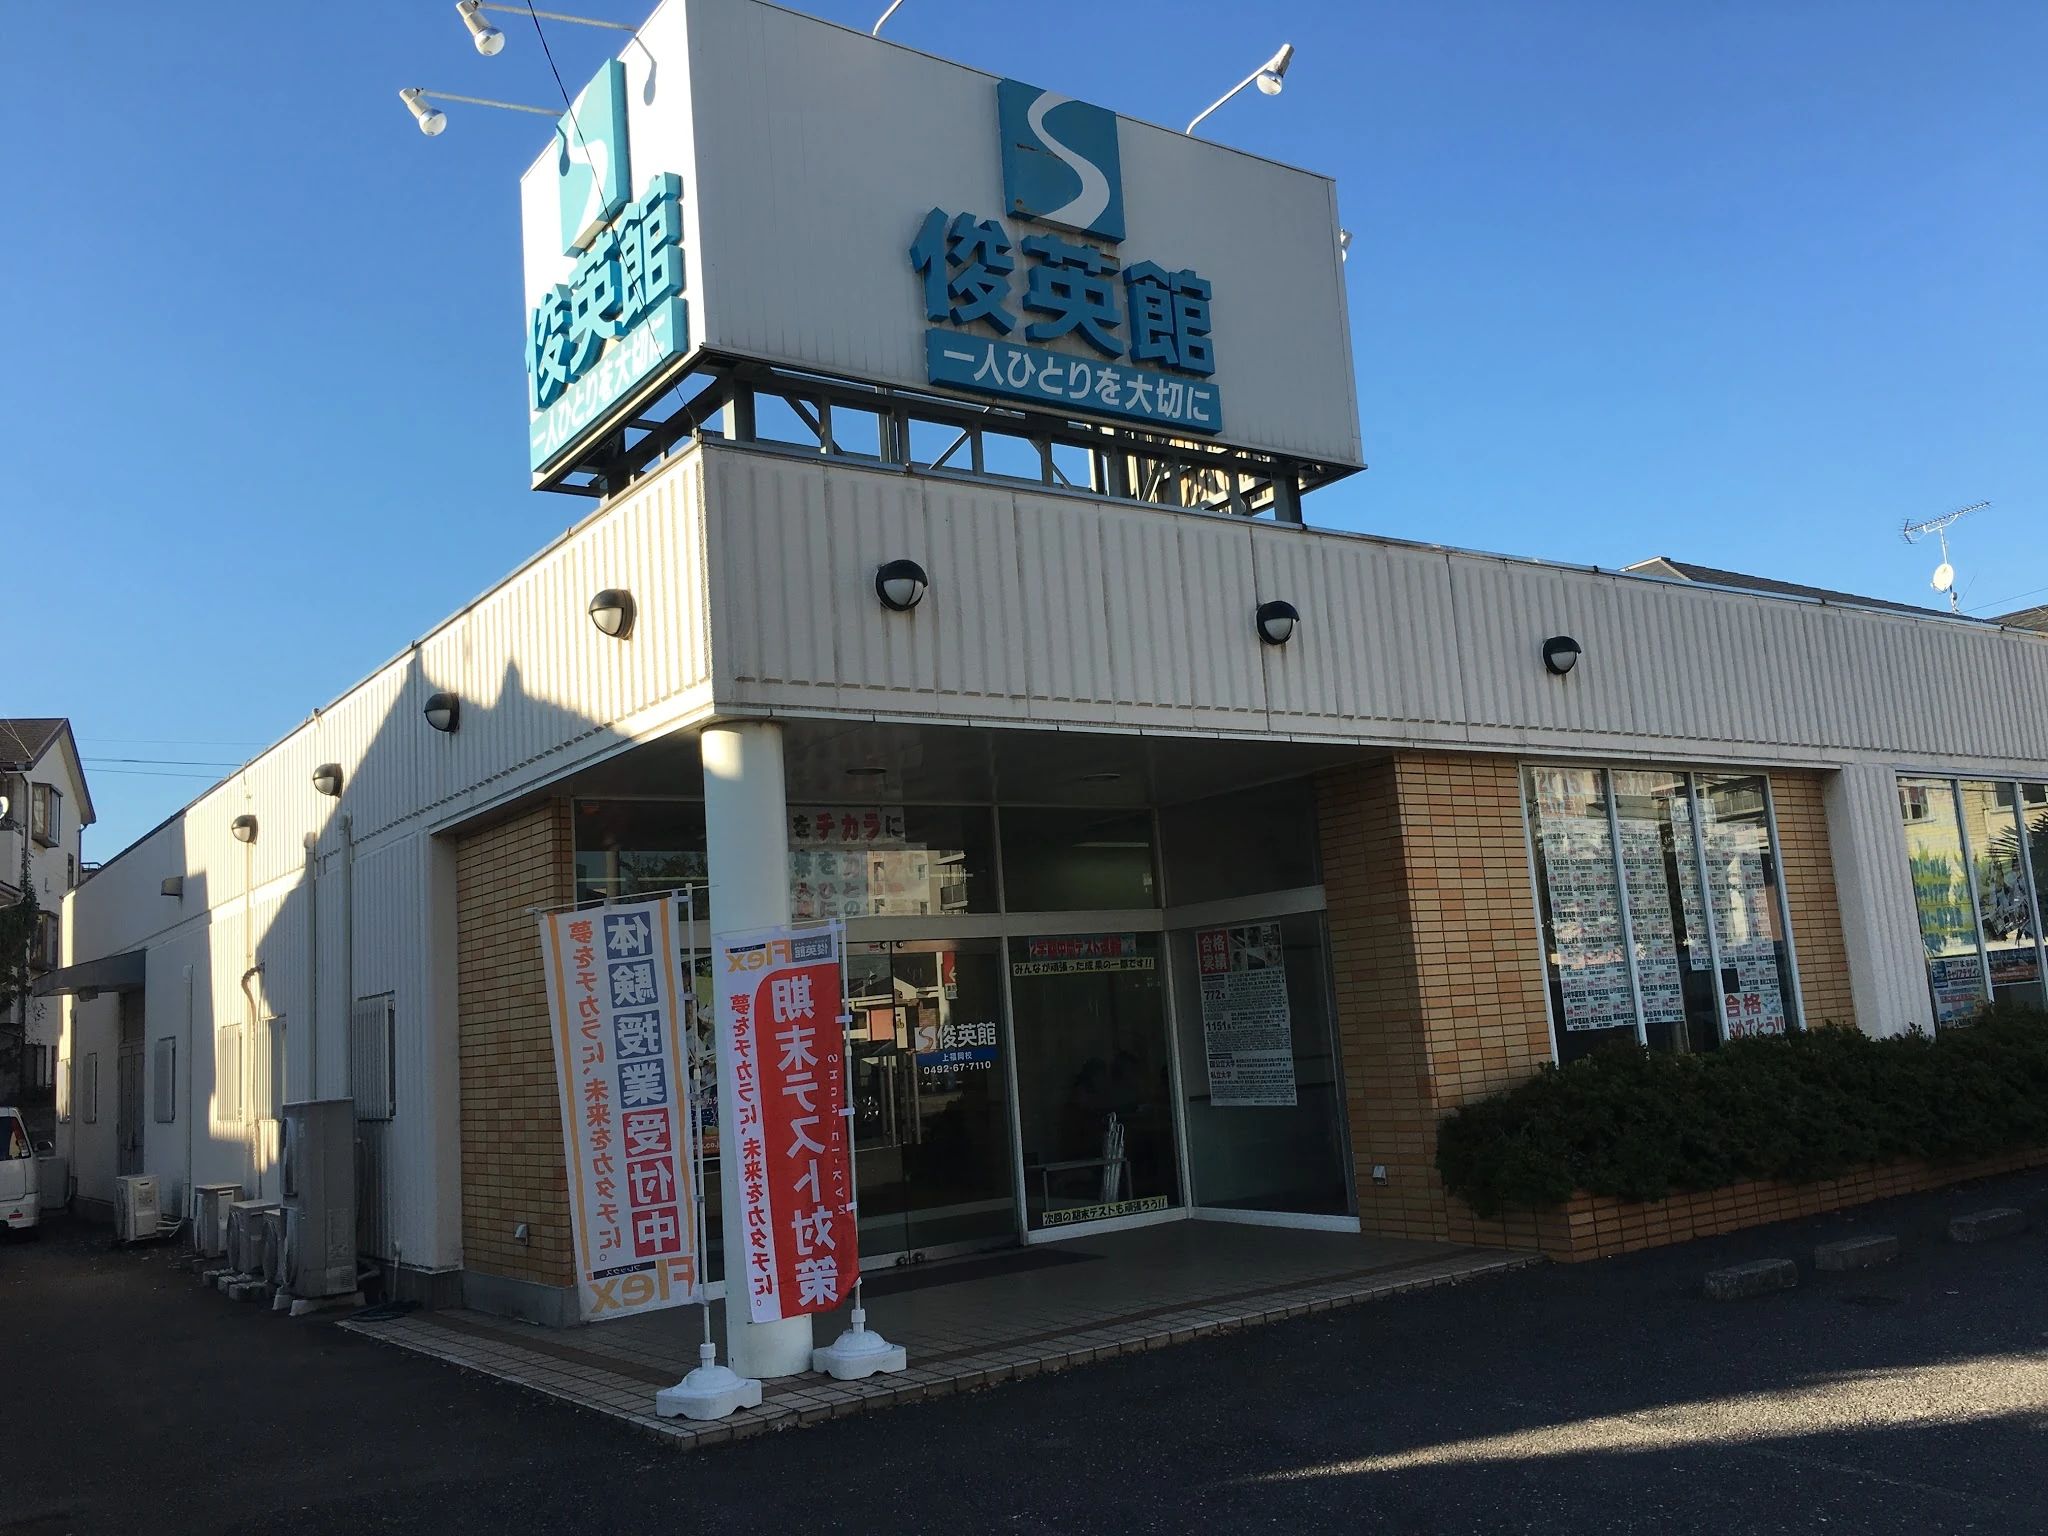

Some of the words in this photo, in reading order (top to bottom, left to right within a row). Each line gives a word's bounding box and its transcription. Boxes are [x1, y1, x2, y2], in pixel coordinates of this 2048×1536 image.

[525, 171, 684, 412] 俊英館
[908, 207, 1216, 377] 俊英館
[943, 343, 1210, 422] 一人ひとりを大切に
[937, 1022, 997, 1049] 俊英館
[1725, 993, 1761, 1017] 合格
